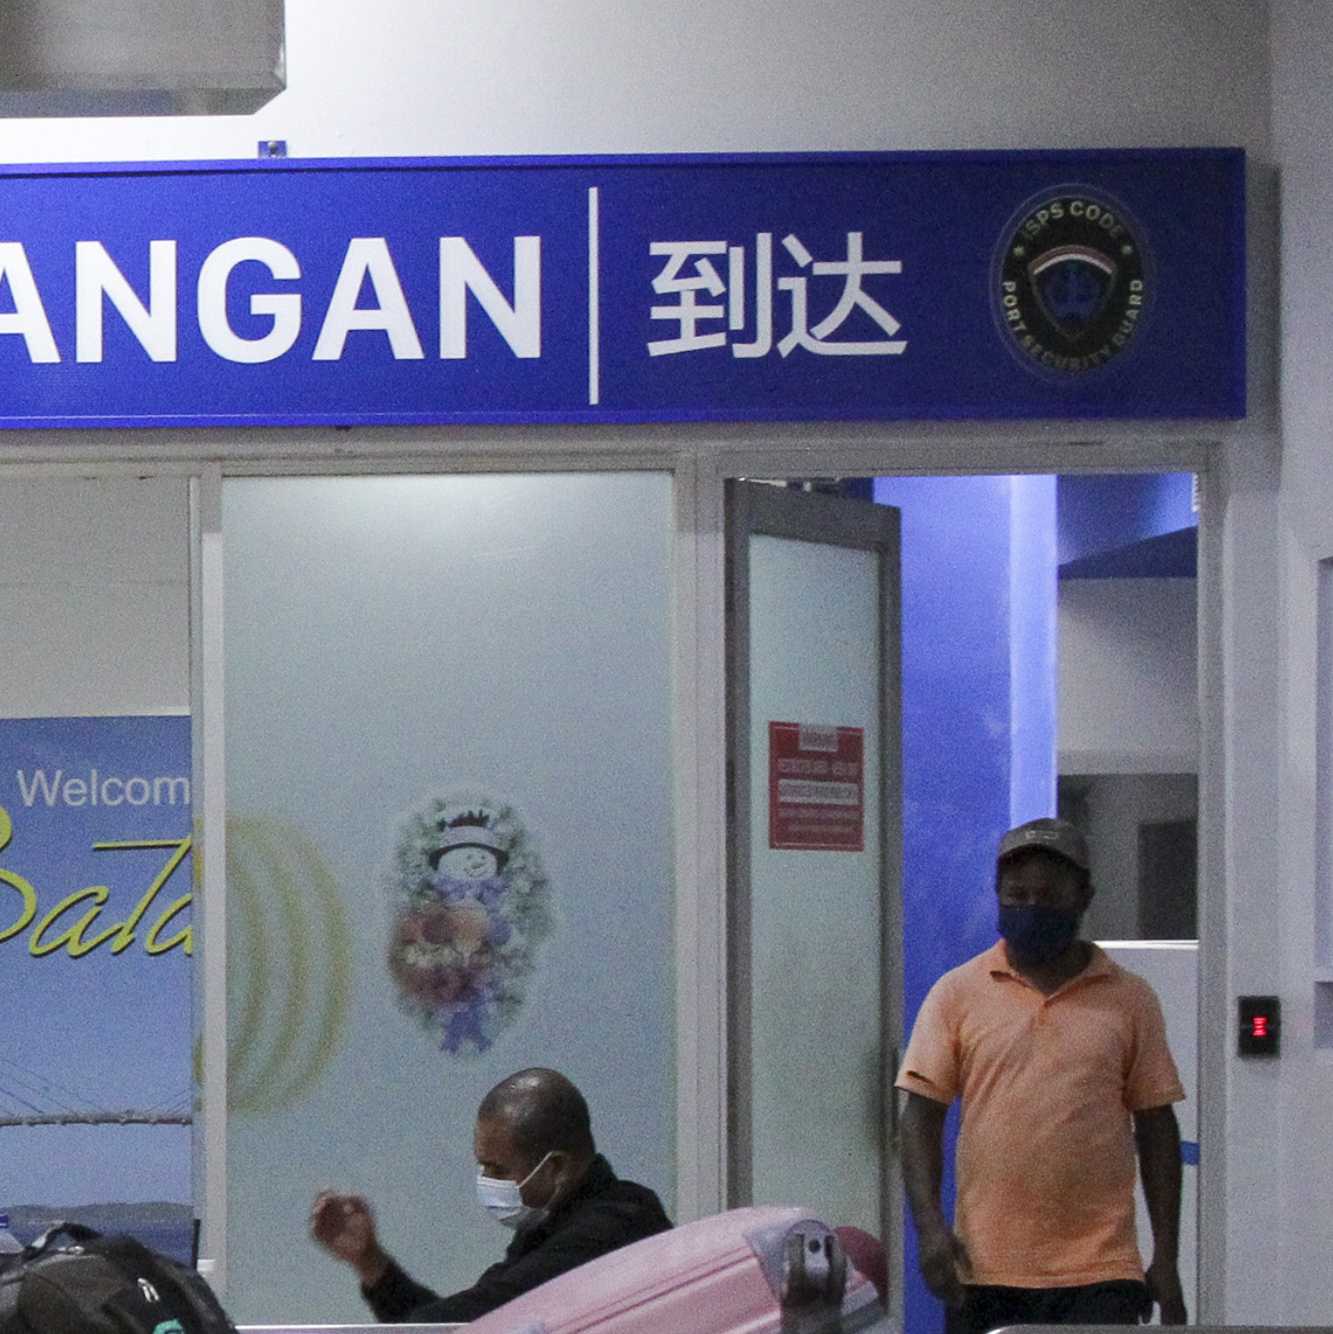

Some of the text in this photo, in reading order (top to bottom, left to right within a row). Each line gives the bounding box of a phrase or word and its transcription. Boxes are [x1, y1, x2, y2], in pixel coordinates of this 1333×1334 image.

[1069, 201, 1124, 239] CODE
[647, 231, 909, 358] 到达
[1002, 282, 1026, 332] PORT
[17, 768, 191, 806] Welcom
